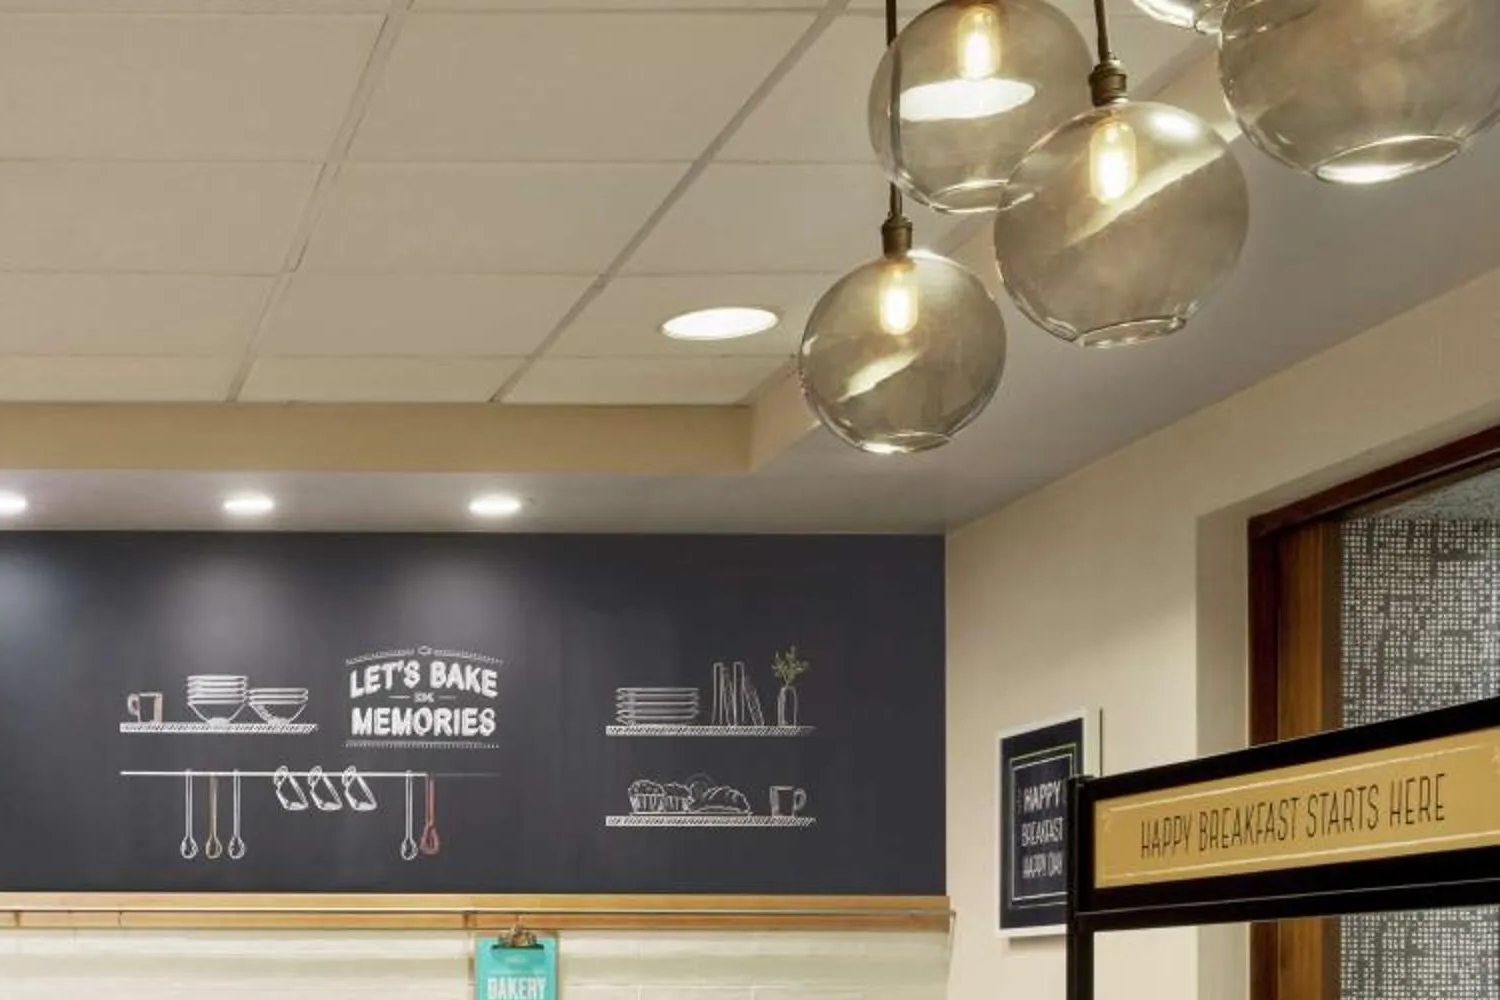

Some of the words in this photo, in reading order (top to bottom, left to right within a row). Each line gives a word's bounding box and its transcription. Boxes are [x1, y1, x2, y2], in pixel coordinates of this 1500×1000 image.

[350, 659, 421, 699] LET'S
[429, 660, 499, 698] BAKE
[351, 706, 496, 737] MEMORIES
[1023, 780, 1062, 813] HAPPY
[1021, 816, 1064, 847] BREAKFAST
[1140, 812, 1194, 859] HAPPY
[1199, 796, 1300, 852] BREAKFAST
[1306, 783, 1380, 838] STARTS
[1388, 772, 1446, 827] HERE
[487, 976, 547, 1000] BAKERY
